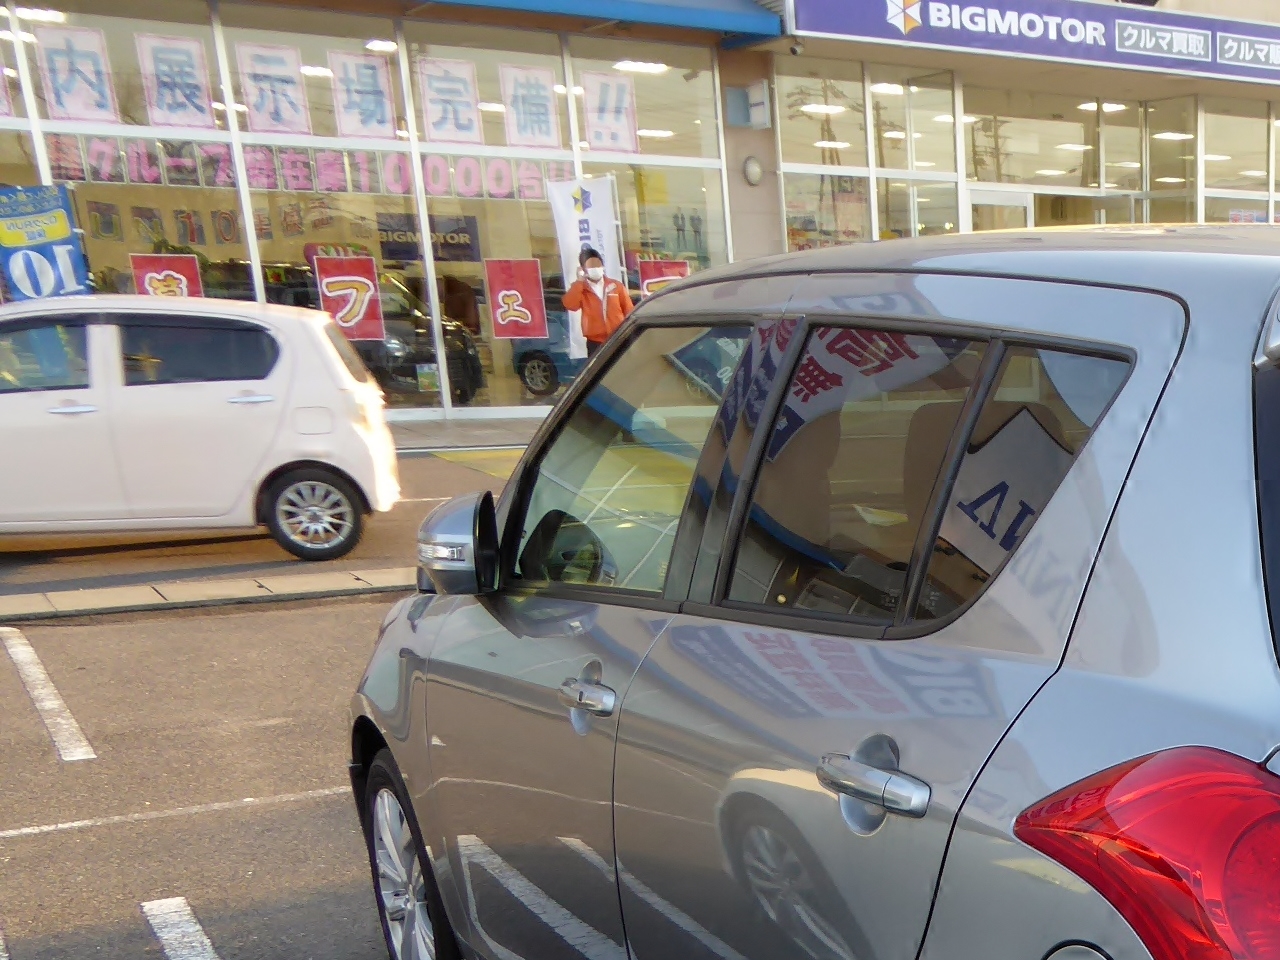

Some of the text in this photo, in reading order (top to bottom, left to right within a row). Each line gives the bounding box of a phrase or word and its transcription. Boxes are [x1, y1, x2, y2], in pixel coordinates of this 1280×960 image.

[928, 2, 1106, 46] BIGMOTOR
[1123, 25, 1204, 56] クルマ買取
